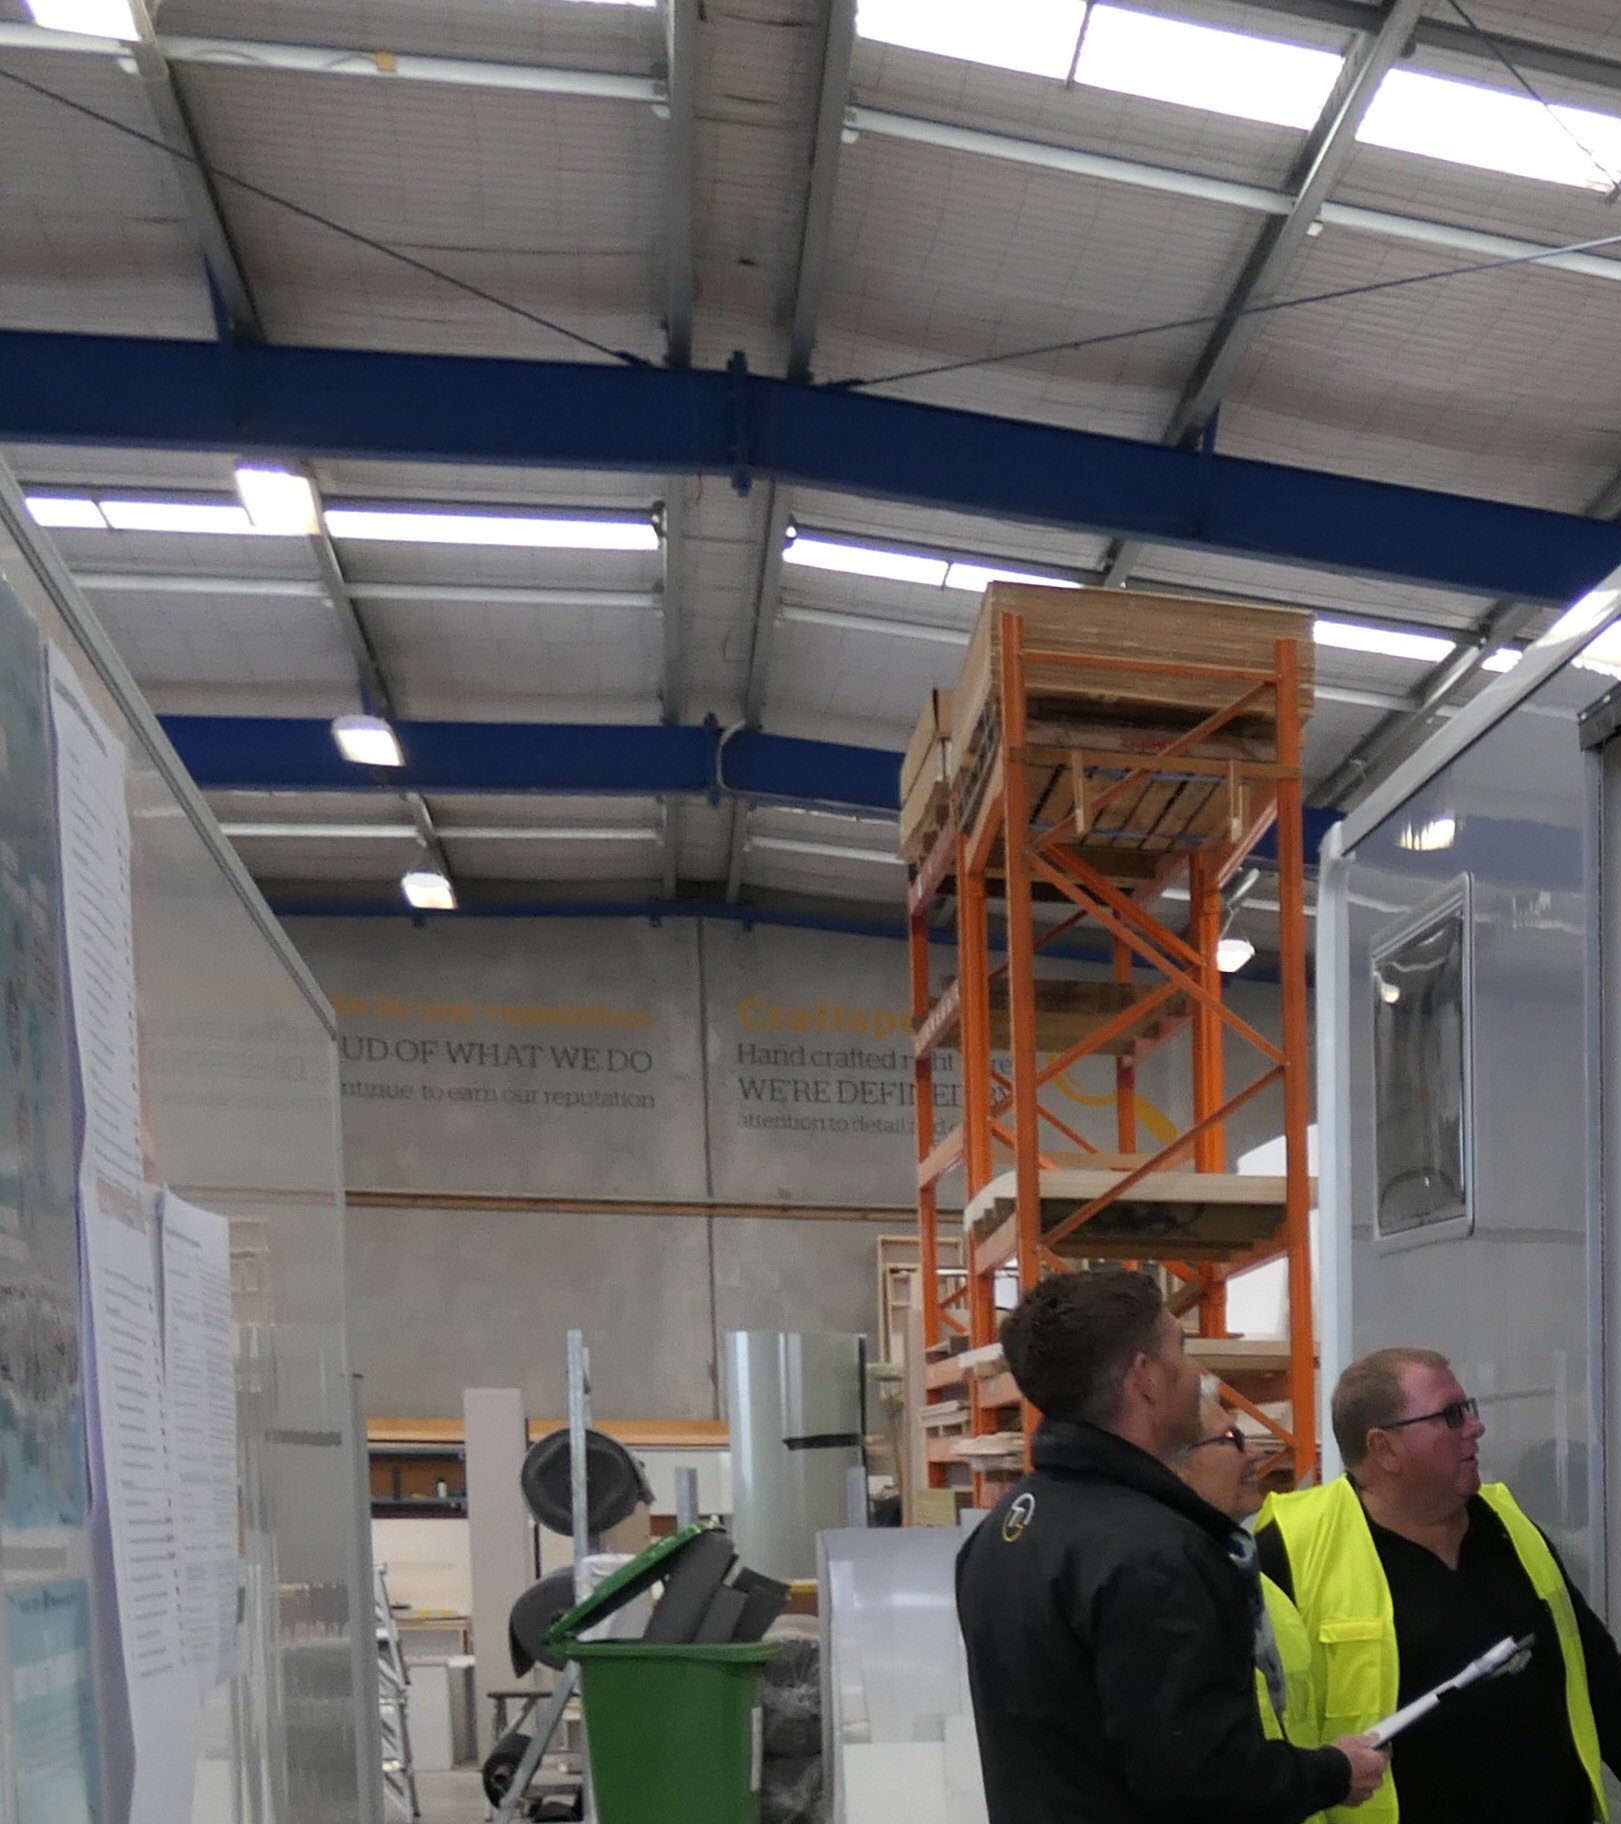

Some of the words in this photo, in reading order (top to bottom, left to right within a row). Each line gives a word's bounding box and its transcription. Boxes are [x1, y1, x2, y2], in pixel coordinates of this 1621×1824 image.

[396, 1038, 438, 1064] OF
[445, 1040, 543, 1069] WHAT
[550, 1045, 600, 1072] WE
[606, 1048, 653, 1074] DO
[737, 1042, 805, 1067] Hand
[810, 1046, 896, 1070] crafted
[902, 1051, 953, 1073] rht
[836, 1080, 964, 1108] DEFIE
